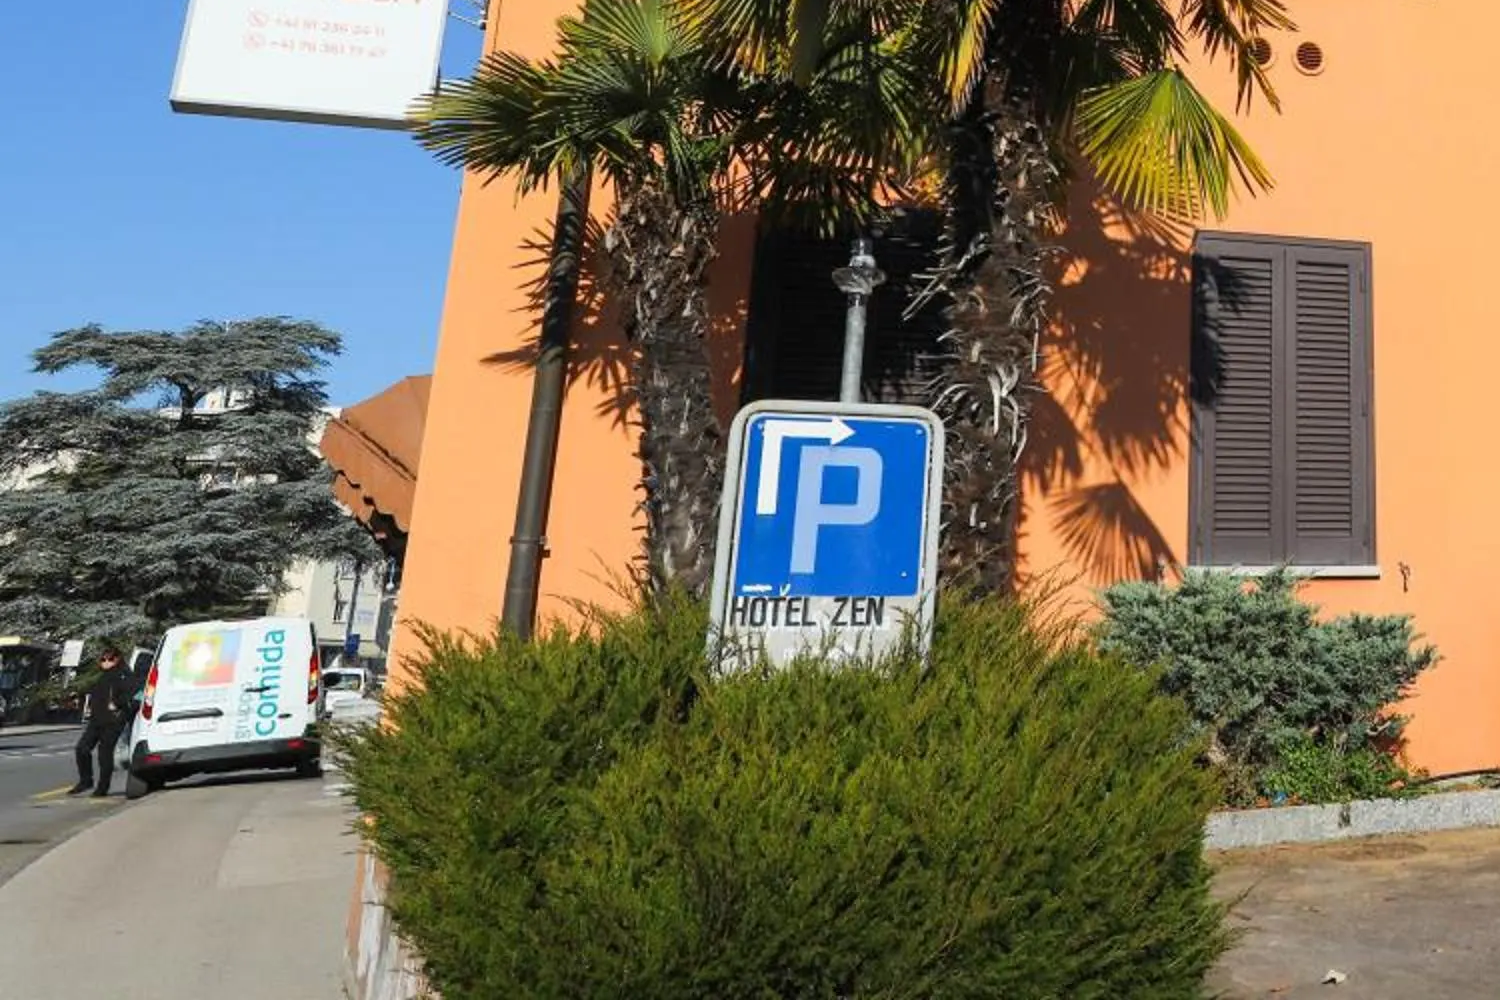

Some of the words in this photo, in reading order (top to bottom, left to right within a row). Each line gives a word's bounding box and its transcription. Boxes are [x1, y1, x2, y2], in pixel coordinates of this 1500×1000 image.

[790, 445, 883, 574] P
[730, 597, 817, 627] HOTEL
[831, 597, 885, 627] ZEN
[255, 629, 286, 736] comida
